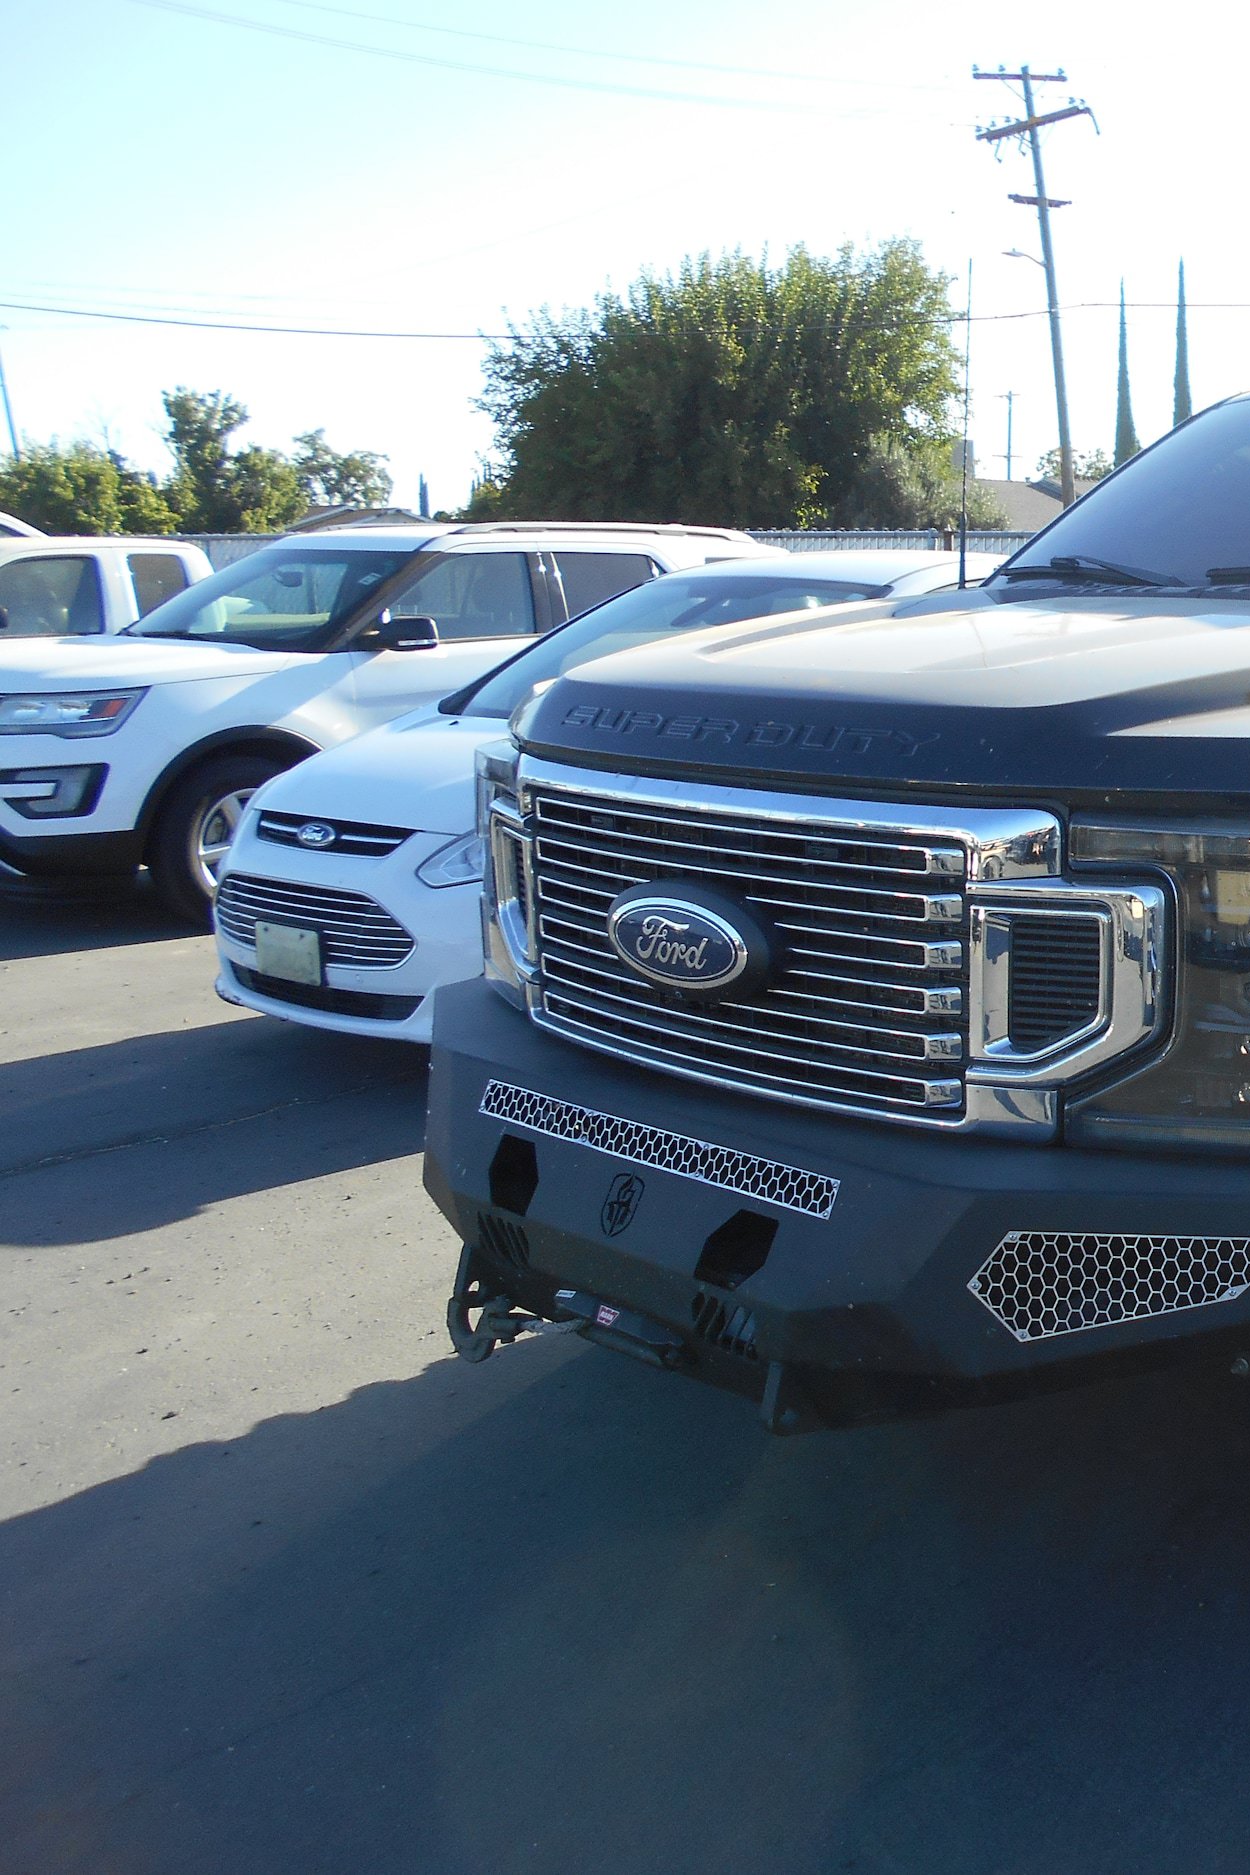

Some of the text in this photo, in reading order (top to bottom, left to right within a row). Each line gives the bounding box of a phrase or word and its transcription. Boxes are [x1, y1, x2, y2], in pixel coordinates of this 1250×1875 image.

[562, 705, 940, 757] SUPER DUTY
[636, 915, 708, 970] Ford
